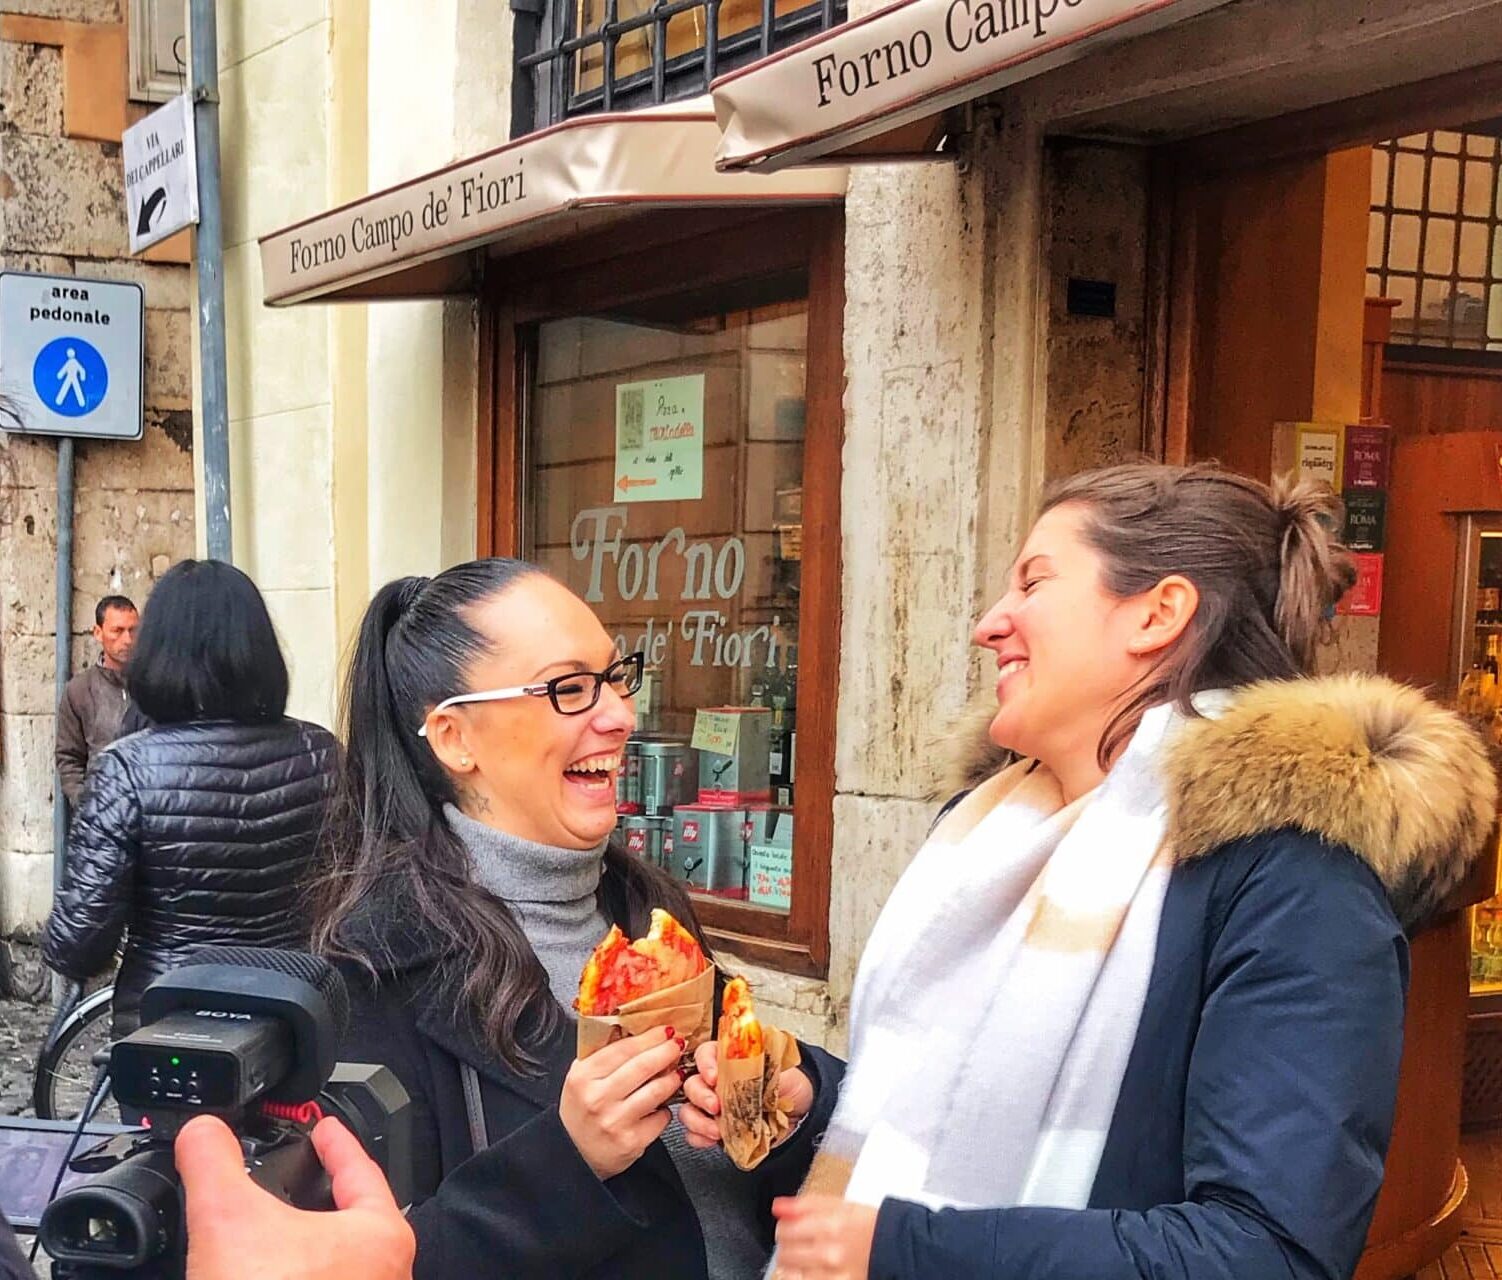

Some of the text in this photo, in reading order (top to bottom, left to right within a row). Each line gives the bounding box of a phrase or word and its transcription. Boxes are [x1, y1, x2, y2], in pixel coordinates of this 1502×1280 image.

[811, 0, 1083, 108] Forno Camp
[146, 131, 160, 150] VIA
[126, 138, 184, 188] DEI CAPPELLARI
[289, 158, 527, 274] Forno Campo de' Fiori
[51, 286, 89, 301] area
[30, 306, 111, 325] pedonale
[570, 506, 745, 602] Forno
[634, 617, 673, 666] de'
[681, 610, 780, 668] Fiori
[683, 825, 698, 840] illy
[628, 836, 644, 851] illy
[195, 1010, 252, 1020] BOYA
